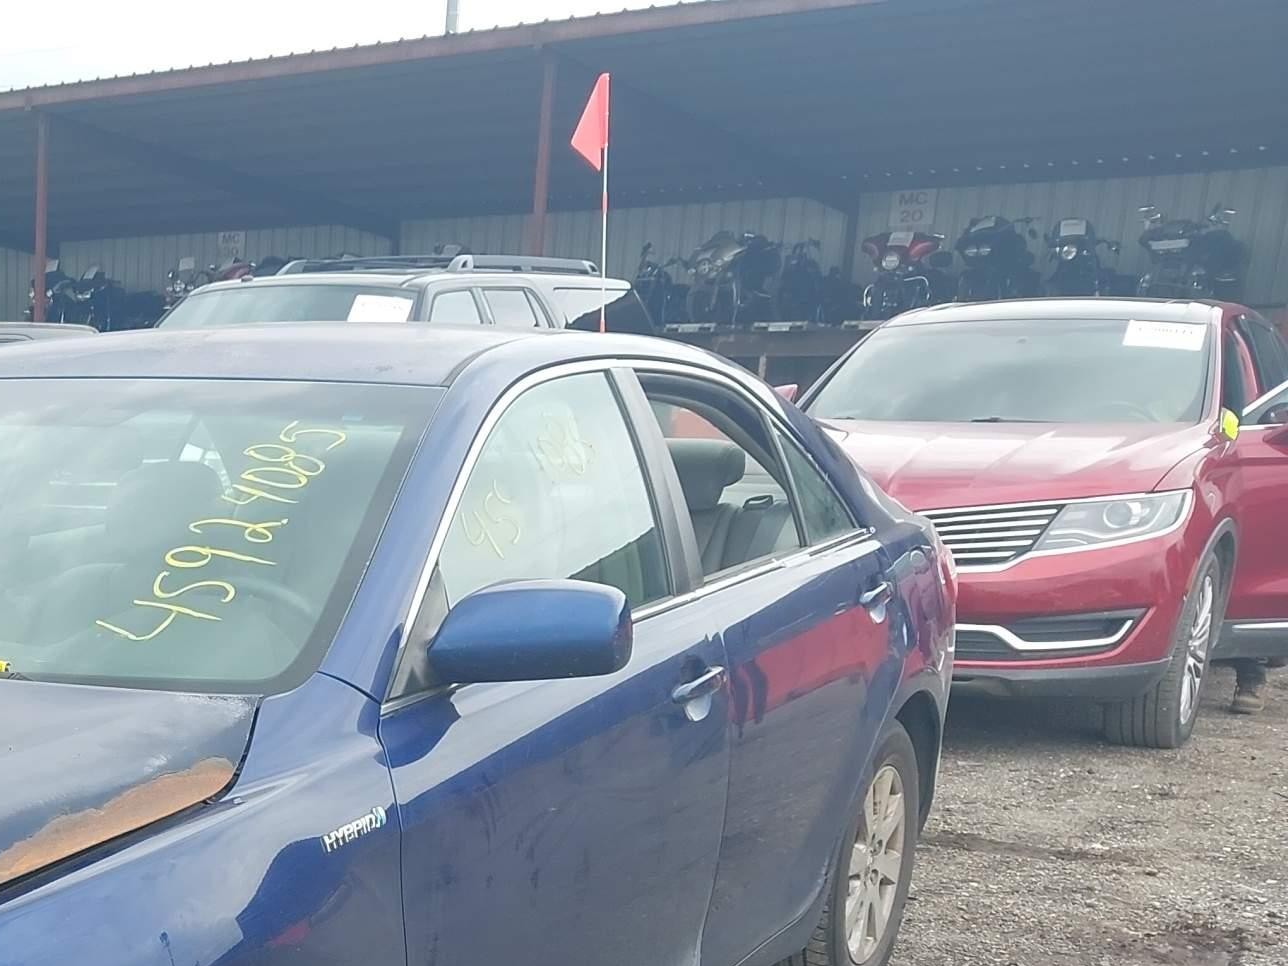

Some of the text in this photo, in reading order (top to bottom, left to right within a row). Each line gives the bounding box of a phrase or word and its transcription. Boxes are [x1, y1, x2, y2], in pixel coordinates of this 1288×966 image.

[898, 191, 929, 206] MC
[900, 210, 923, 223] 20
[96, 420, 347, 641] 45924085
[322, 813, 376, 853] HYBRID
